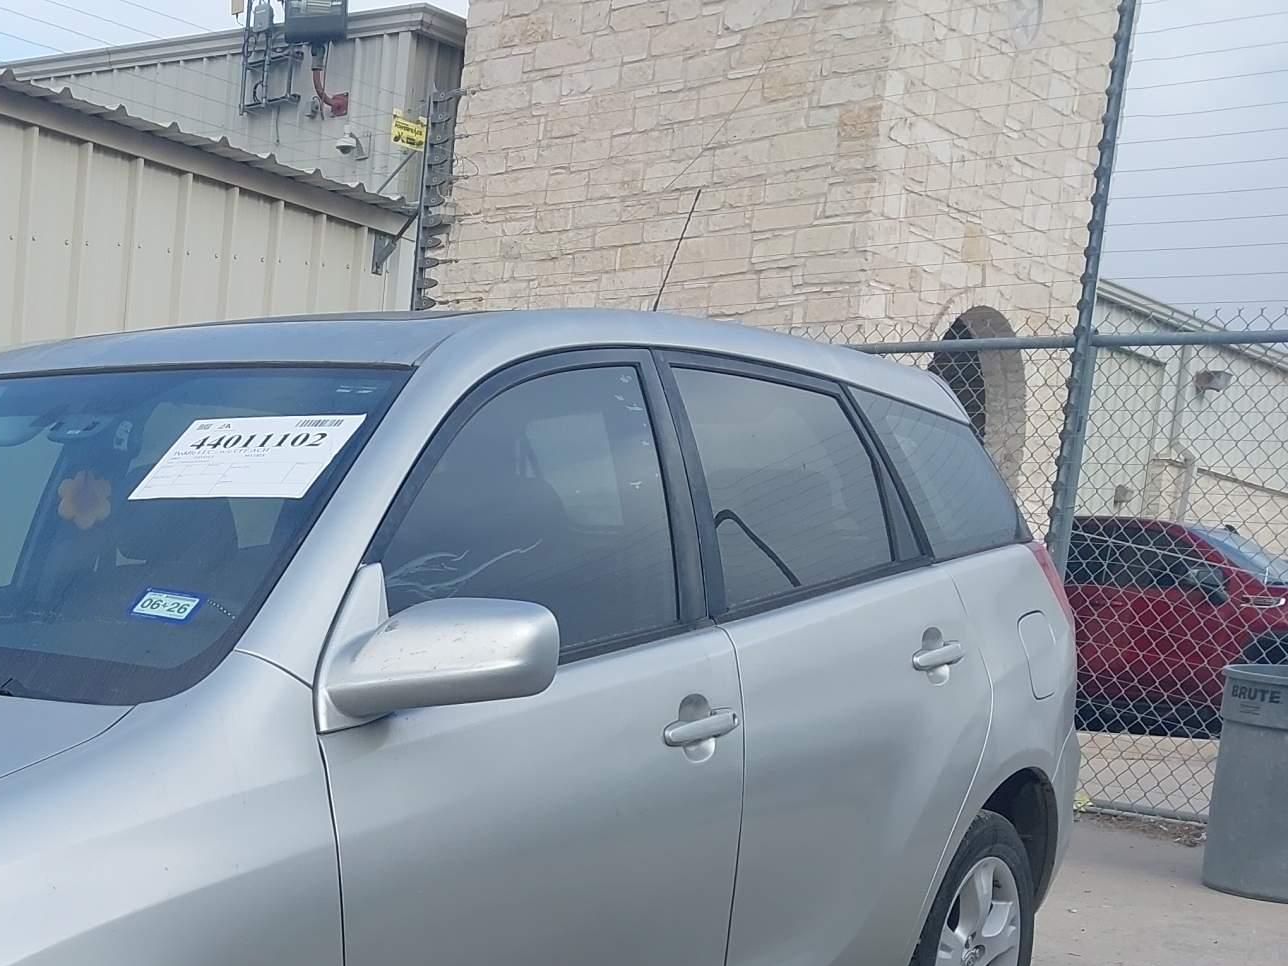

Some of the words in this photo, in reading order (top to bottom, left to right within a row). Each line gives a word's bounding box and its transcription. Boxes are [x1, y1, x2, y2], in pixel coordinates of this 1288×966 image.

[190, 432, 329, 450] 44011102
[140, 598, 162, 611] 06
[166, 601, 191, 615] 26
[1231, 684, 1281, 704] BRUTE
